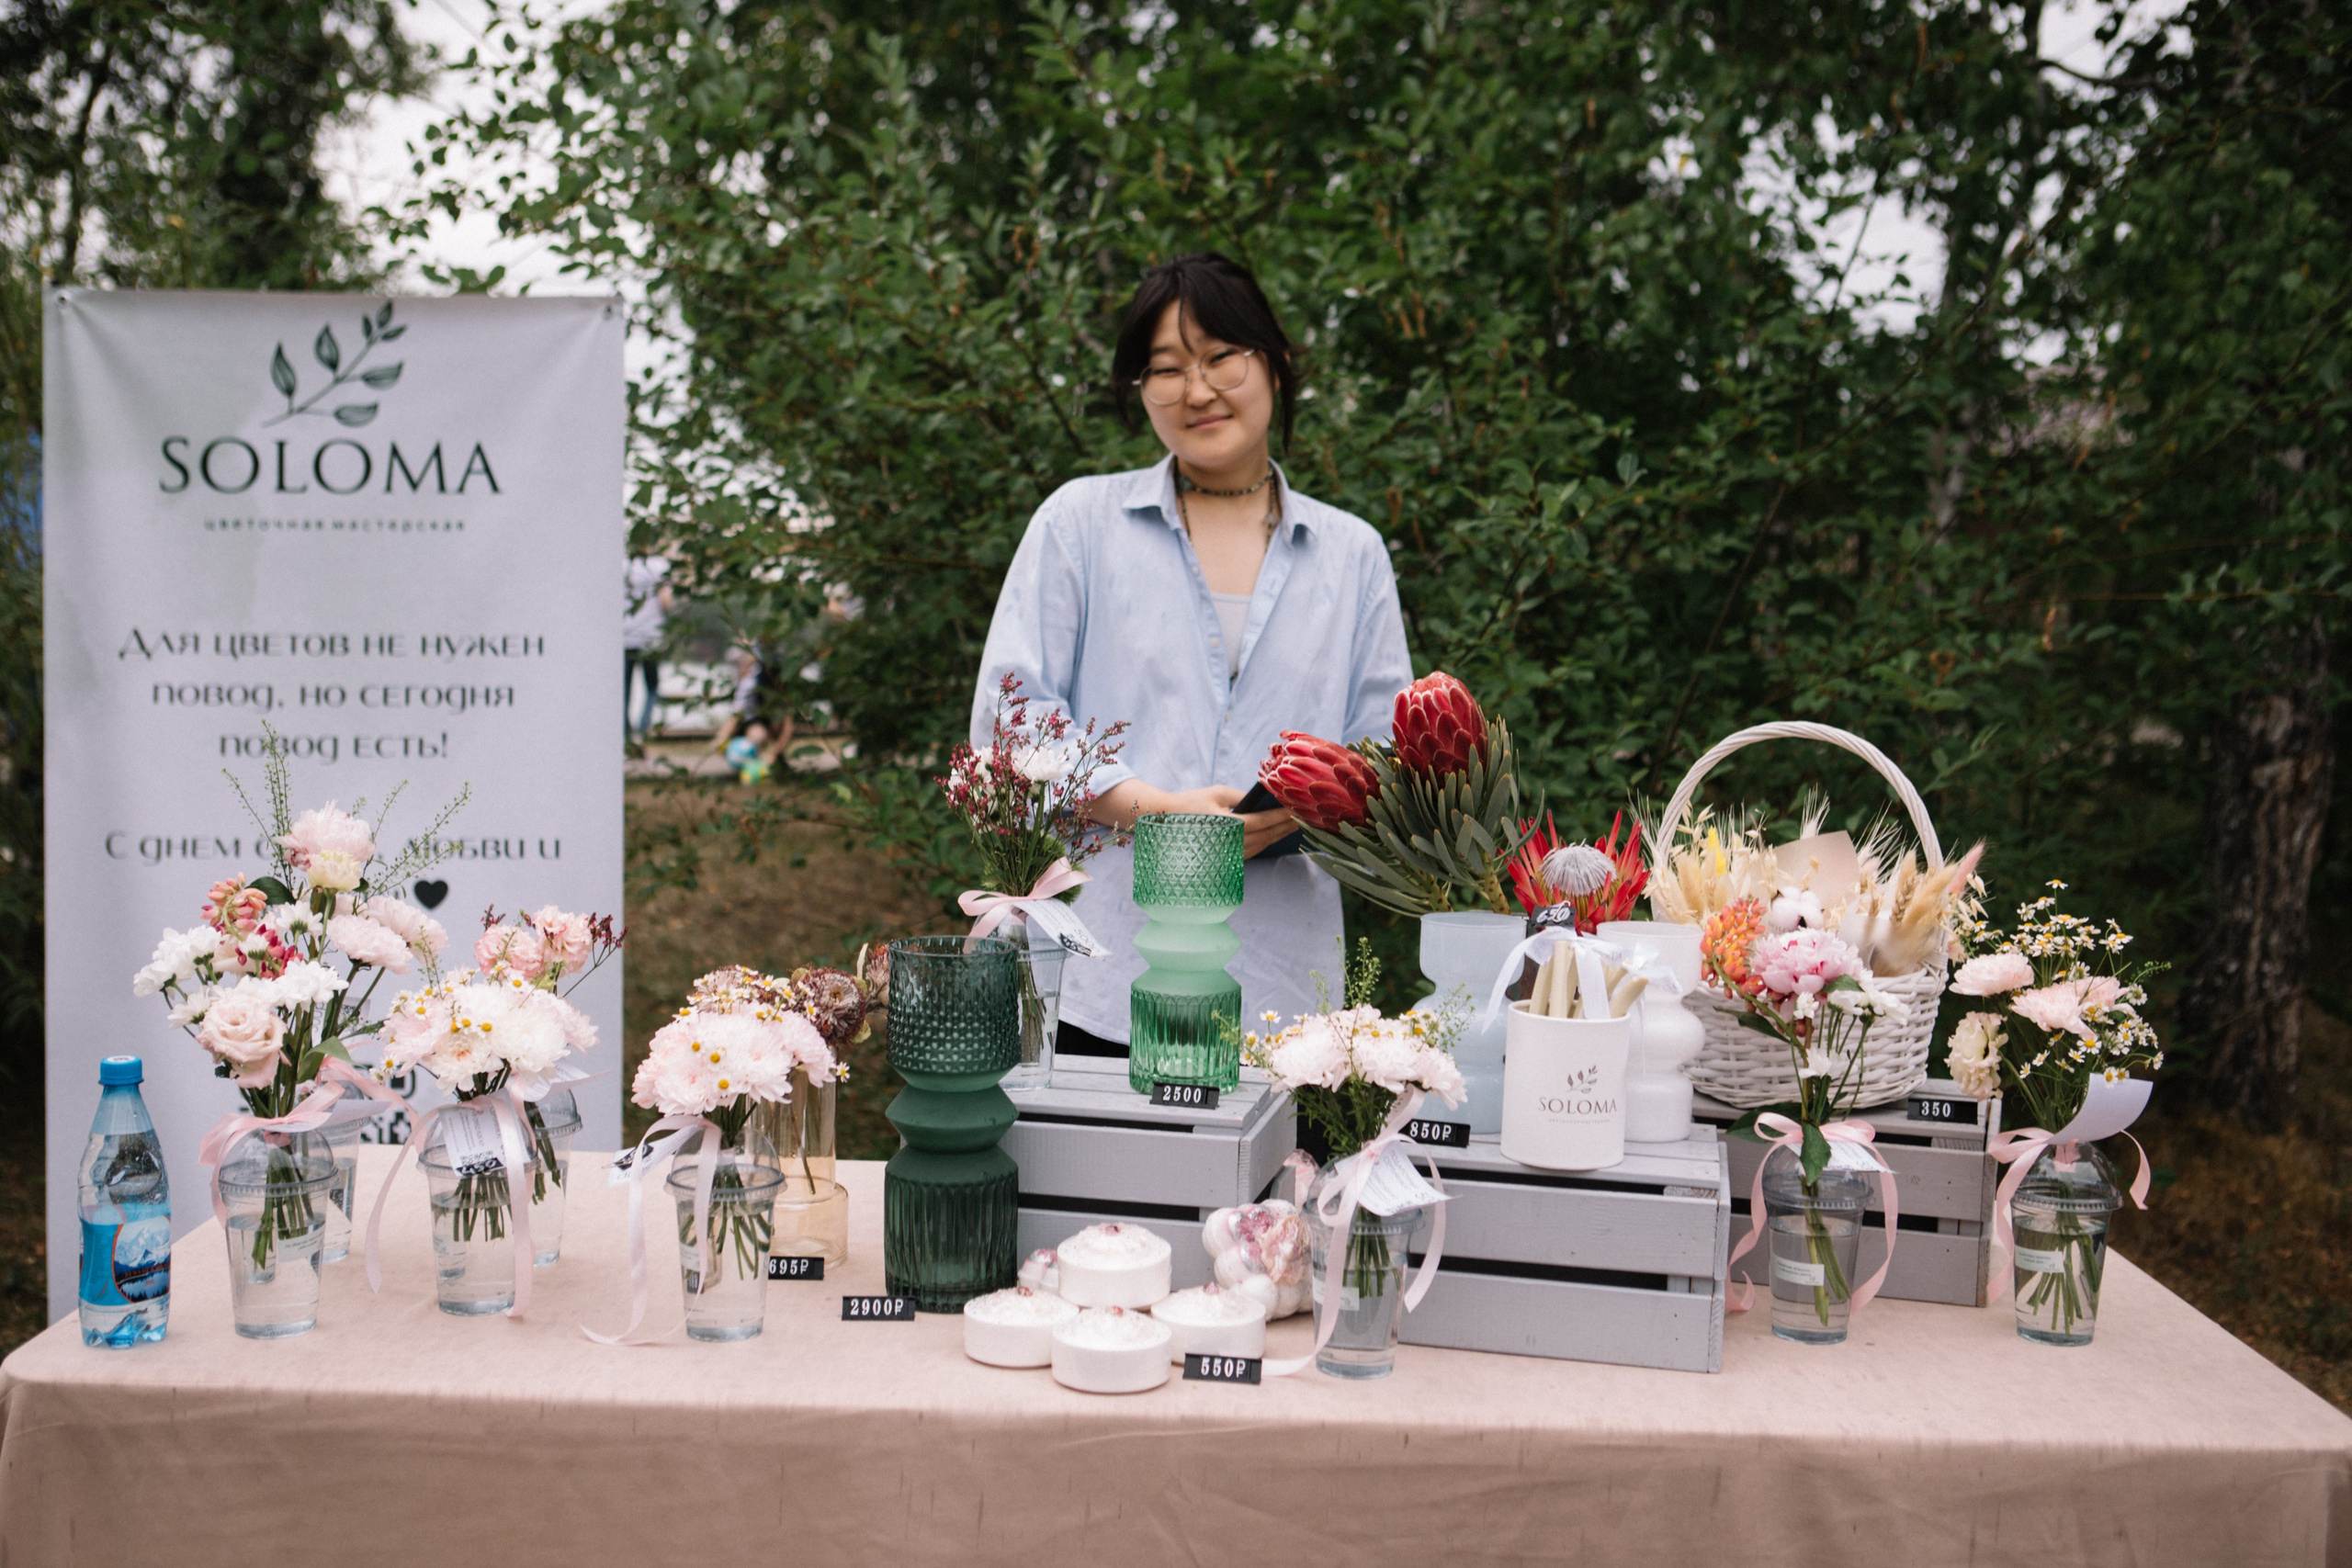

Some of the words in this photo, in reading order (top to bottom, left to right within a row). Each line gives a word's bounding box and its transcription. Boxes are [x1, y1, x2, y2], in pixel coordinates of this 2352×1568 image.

[160, 435, 504, 496] SOLOMA
[204, 518, 326, 534] цветочная
[332, 518, 467, 536] мастерская
[105, 829, 128, 862] С
[1162, 1085, 1202, 1104] 2500
[1538, 1097, 1618, 1115] SOLOMA
[1921, 1100, 1951, 1118] 350
